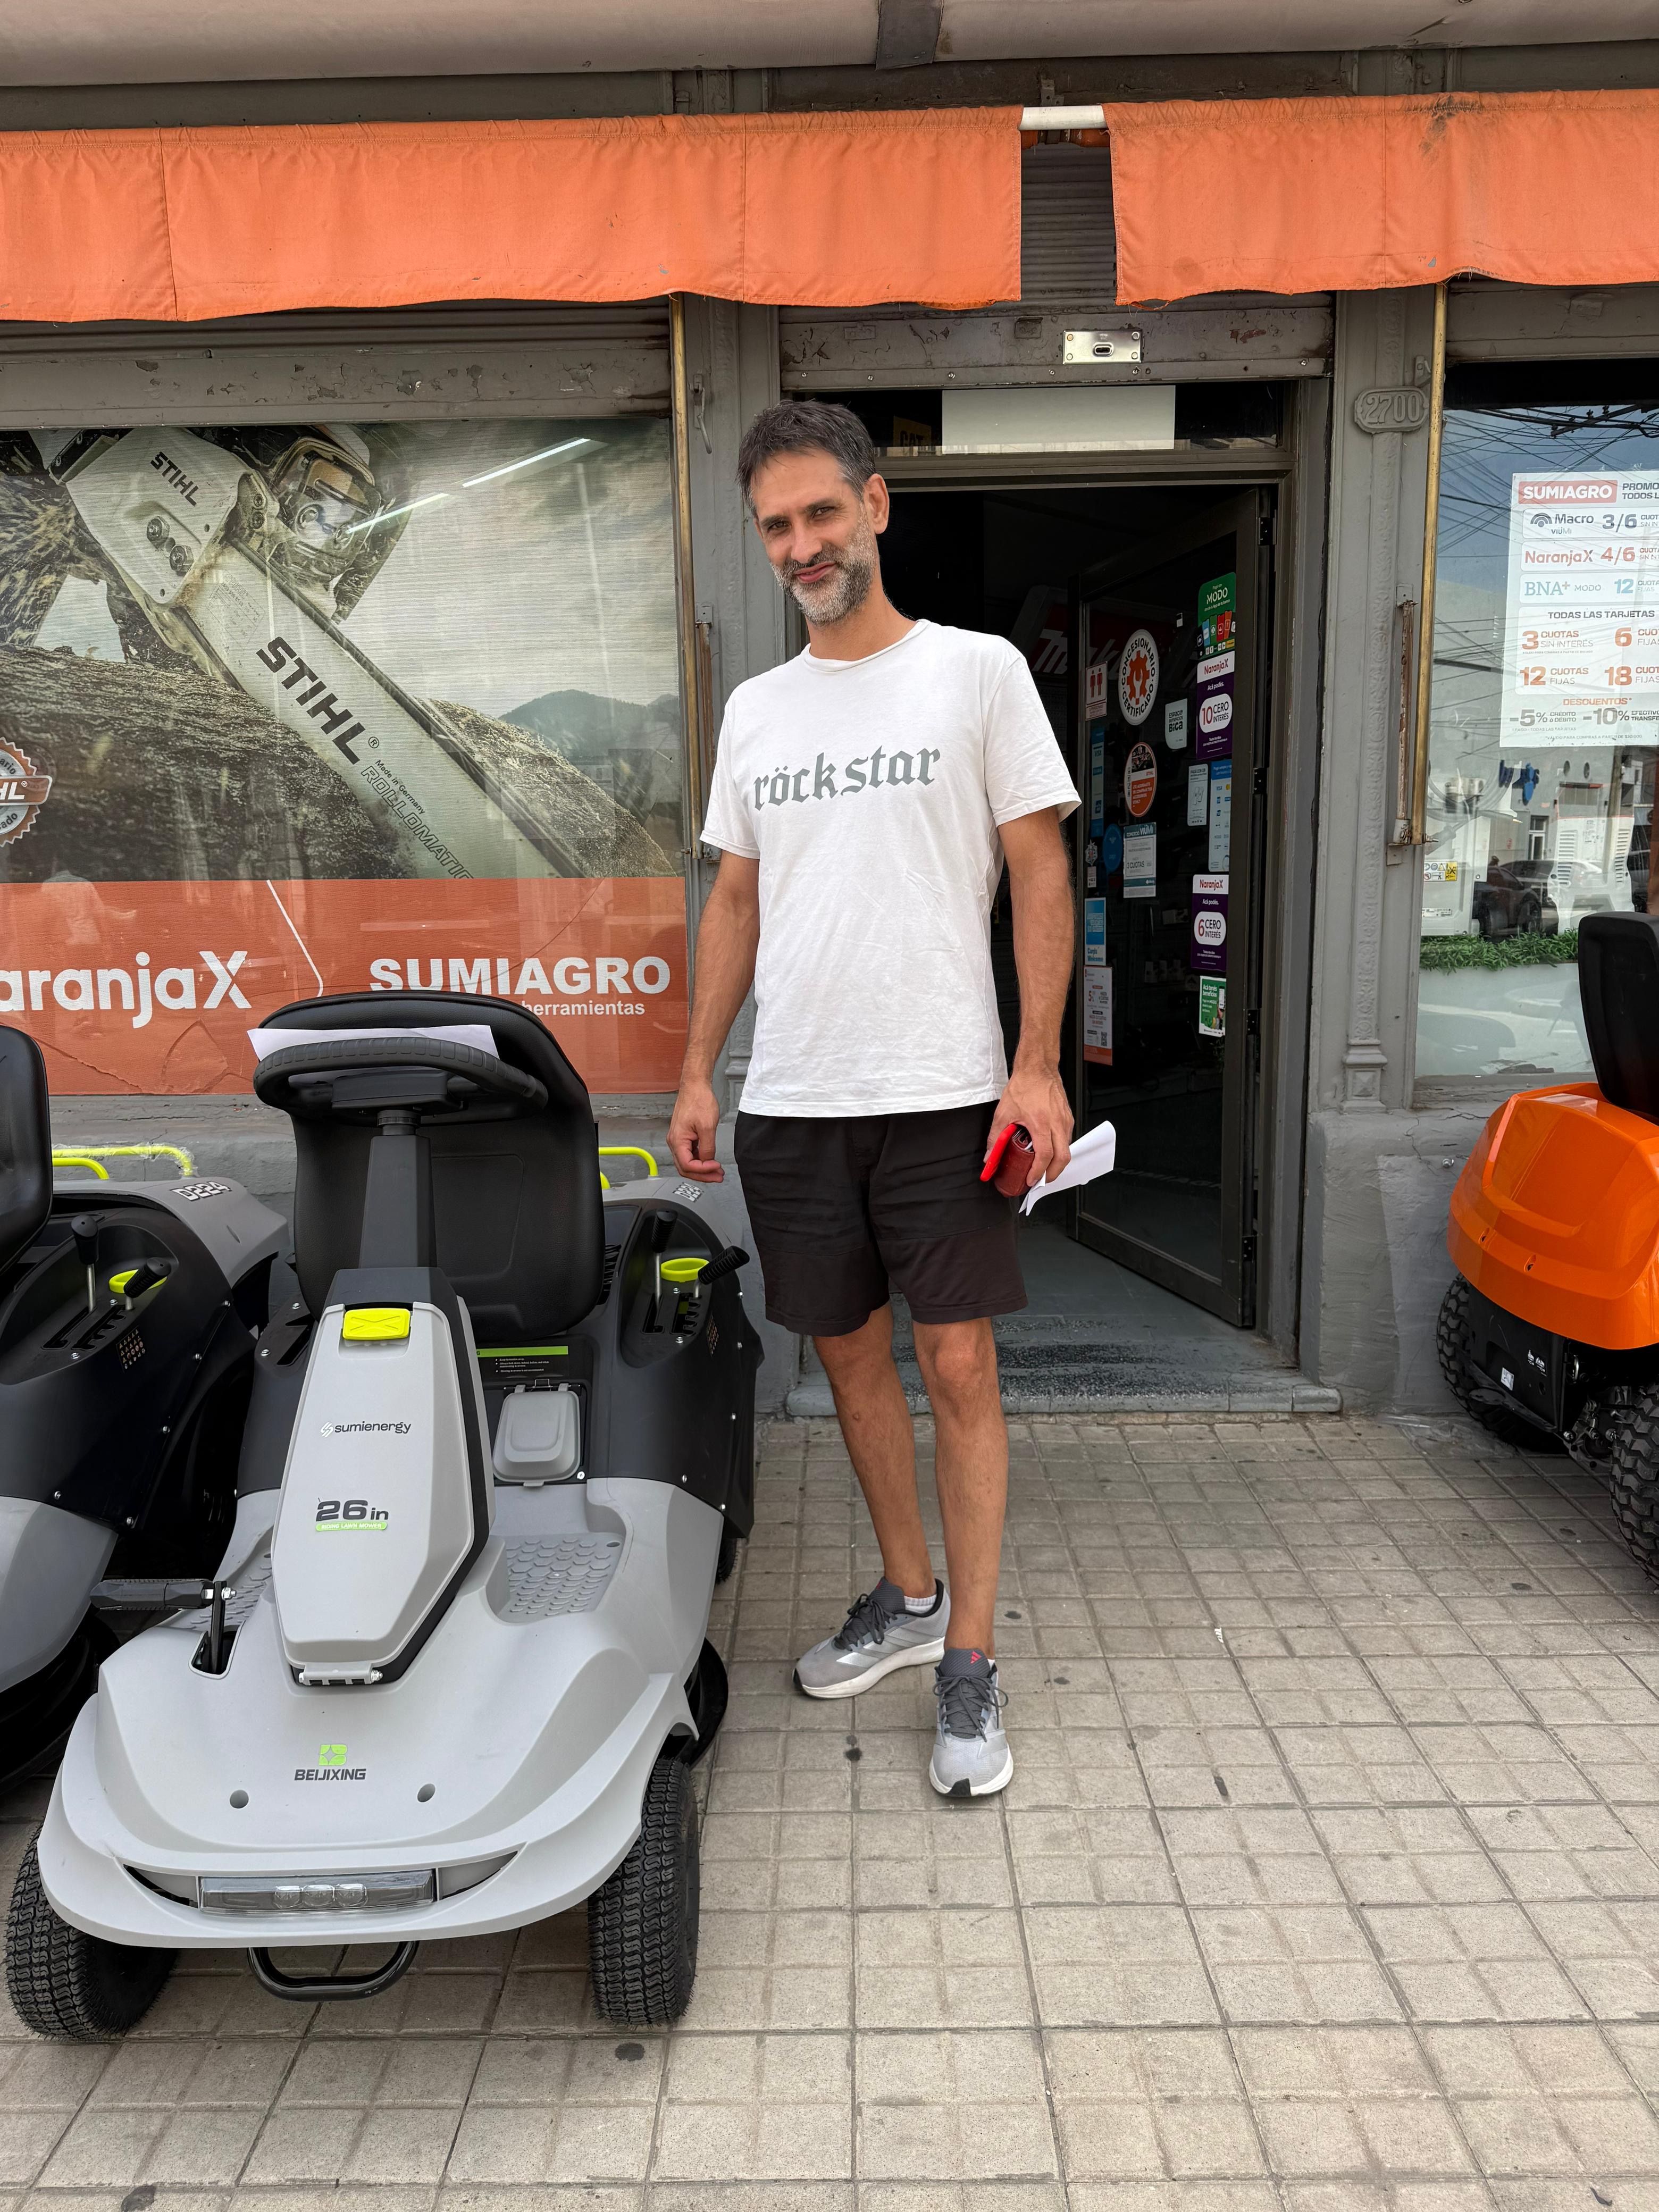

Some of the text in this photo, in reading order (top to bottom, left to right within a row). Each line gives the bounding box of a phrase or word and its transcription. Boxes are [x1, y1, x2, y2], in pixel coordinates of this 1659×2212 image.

[1365, 393, 1420, 423] 2700
[150, 451, 197, 507] STIHL
[1522, 485, 1612, 499] SUMIAGRO
[1554, 514, 1594, 524] Macro
[1602, 514, 1637, 532] 3/6
[1601, 547, 1636, 565] 4/6
[1614, 579, 1634, 594] 12
[1206, 587, 1228, 605] MODO
[1522, 631, 1539, 650] 3
[1615, 627, 1632, 647] 6
[1121, 638, 1155, 686] CONCESIONARIO
[1519, 666, 1546, 686] 12
[1604, 666, 1632, 686] 18
[1122, 683, 1153, 717] CERTIFICADO
[1213, 701, 1229, 714] CERO
[1202, 706, 1213, 725] 10
[1213, 713, 1229, 723] INTERÉS
[1169, 721, 1183, 732] Bica
[375, 760, 425, 815] Made in Germany
[1199, 919, 1204, 936] 6
[1205, 919, 1221, 930] CERO
[1205, 931, 1221, 939] INTERÉS
[370, 956, 671, 995] SUMIAGRO
[0, 951, 252, 1029] aranjaX
[522, 1000, 646, 1016] herramientas
[170, 1181, 232, 1202] D224
[334, 1421, 412, 1434] sumienergy
[295, 1768, 366, 1781] BEIJIXING
